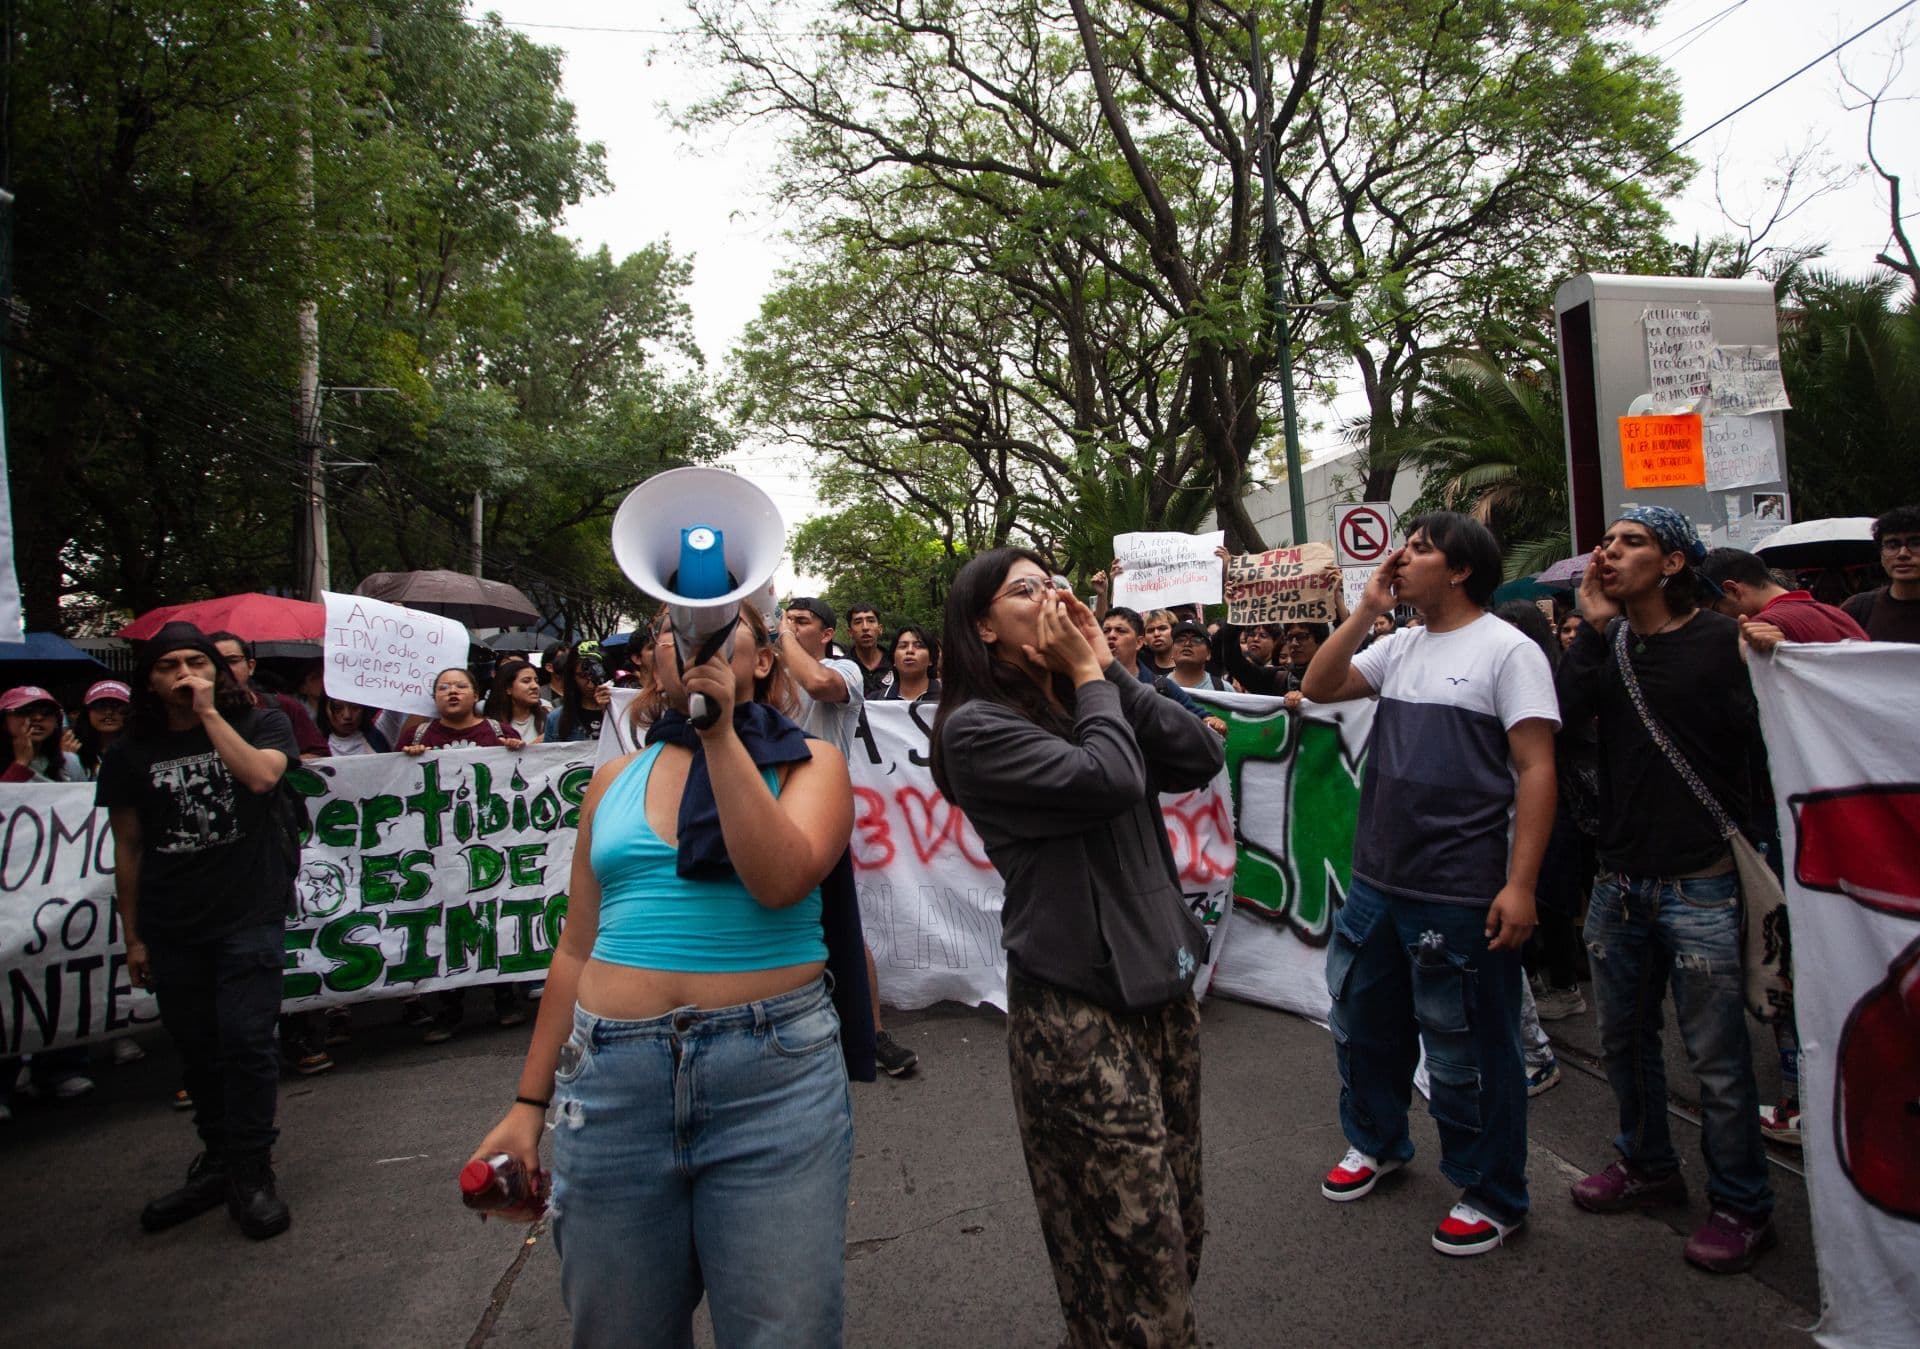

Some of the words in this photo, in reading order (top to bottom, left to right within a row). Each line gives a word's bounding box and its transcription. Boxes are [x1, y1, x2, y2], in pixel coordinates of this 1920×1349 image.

[1704, 421, 1736, 443] Todo
[1743, 420, 1752, 438] el
[1732, 443, 1749, 455] en
[1229, 556, 1255, 569] EL
[1259, 548, 1302, 567] IPN
[1247, 567, 1266, 581] DE
[1271, 563, 1304, 577] SUS
[1230, 600, 1248, 612] NO
[1251, 597, 1267, 609] DE
[1271, 590, 1301, 606] SUS
[1231, 601, 1332, 624] DIRECTORES.
[347, 603, 415, 639] Amo
[427, 620, 444, 646] al
[334, 652, 401, 675] quienes
[408, 662, 422, 679] lo
[388, 643, 419, 661] odio
[426, 655, 435, 665] a
[354, 671, 423, 697] destruyen
[457, 843, 548, 893] DE
